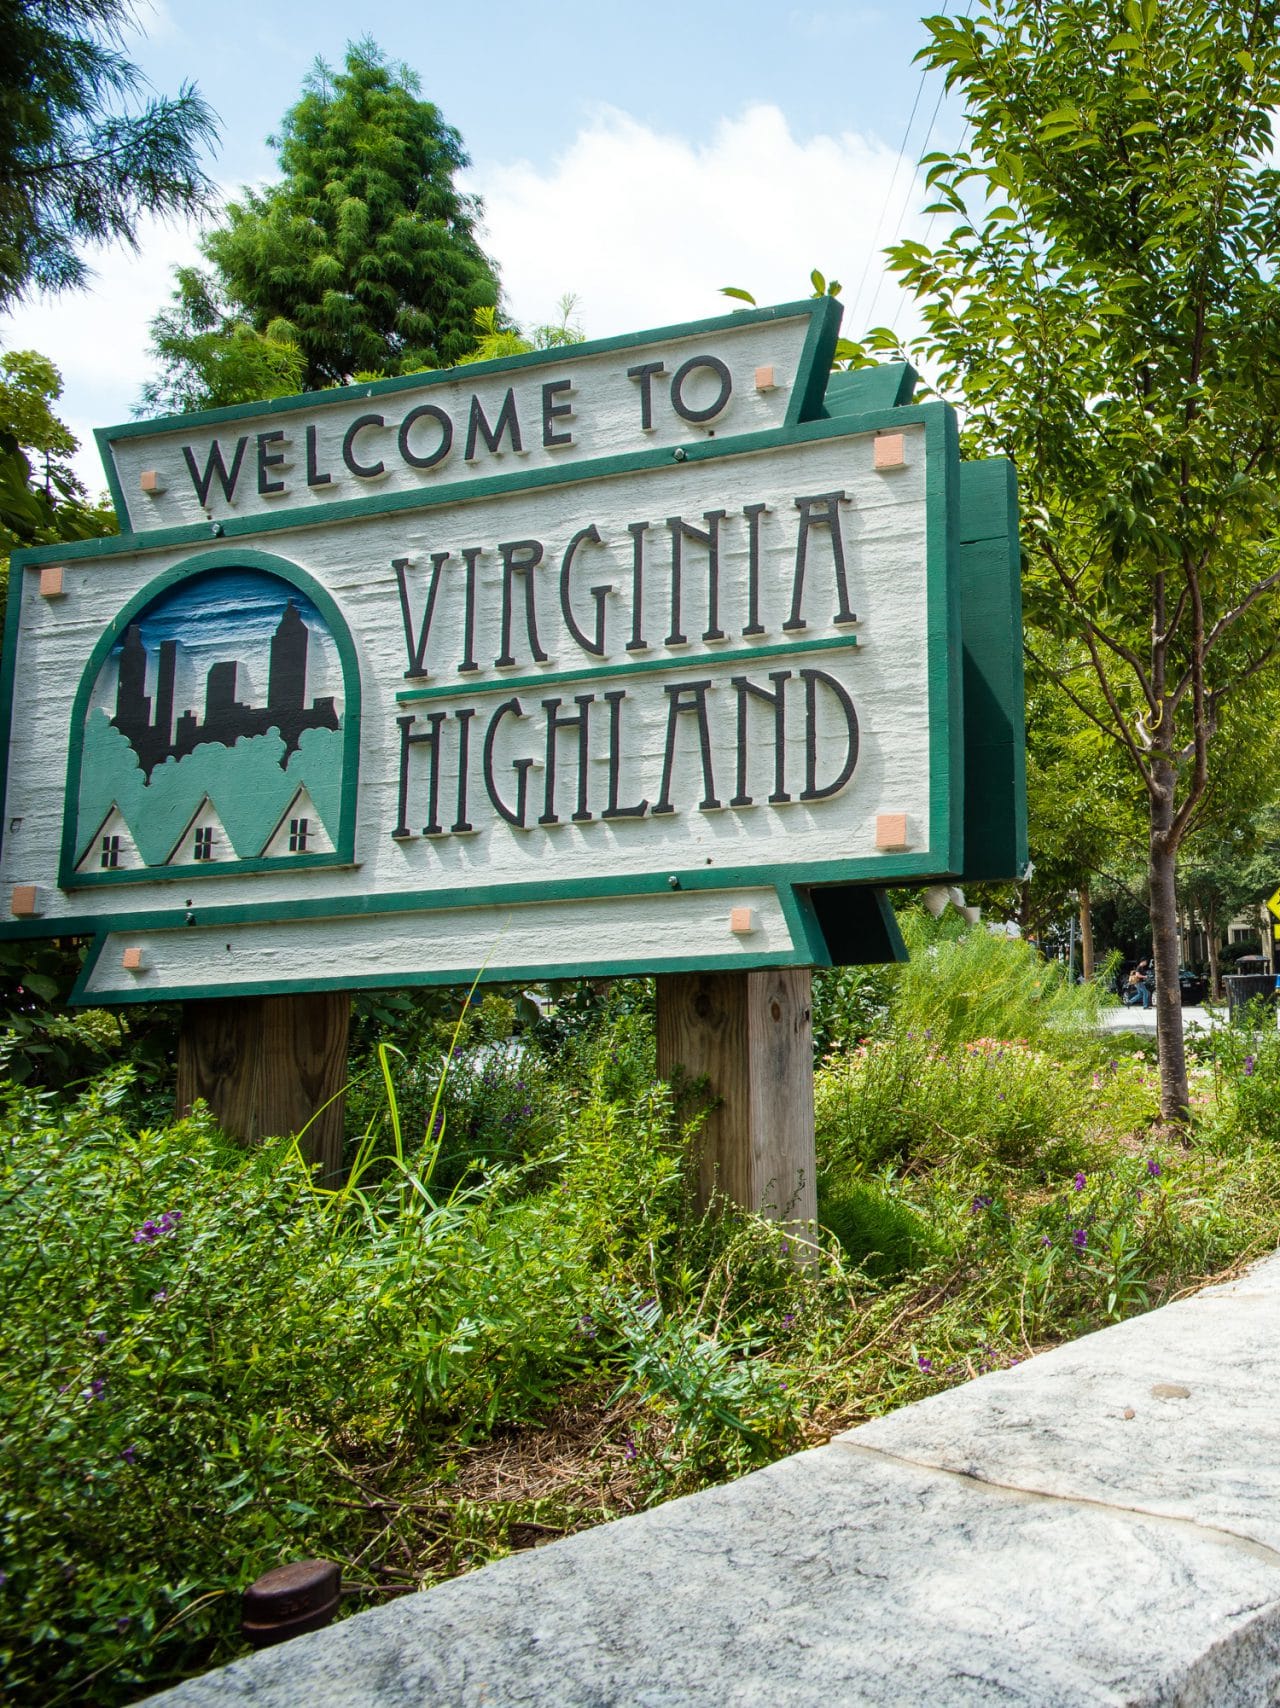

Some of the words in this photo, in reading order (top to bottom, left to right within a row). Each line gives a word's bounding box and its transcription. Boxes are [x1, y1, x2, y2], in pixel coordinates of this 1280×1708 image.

[182, 380, 571, 508] WELCOME
[627, 356, 732, 429] TO
[391, 490, 857, 679] VIRGINIA
[391, 669, 859, 838] HIGHLAND
